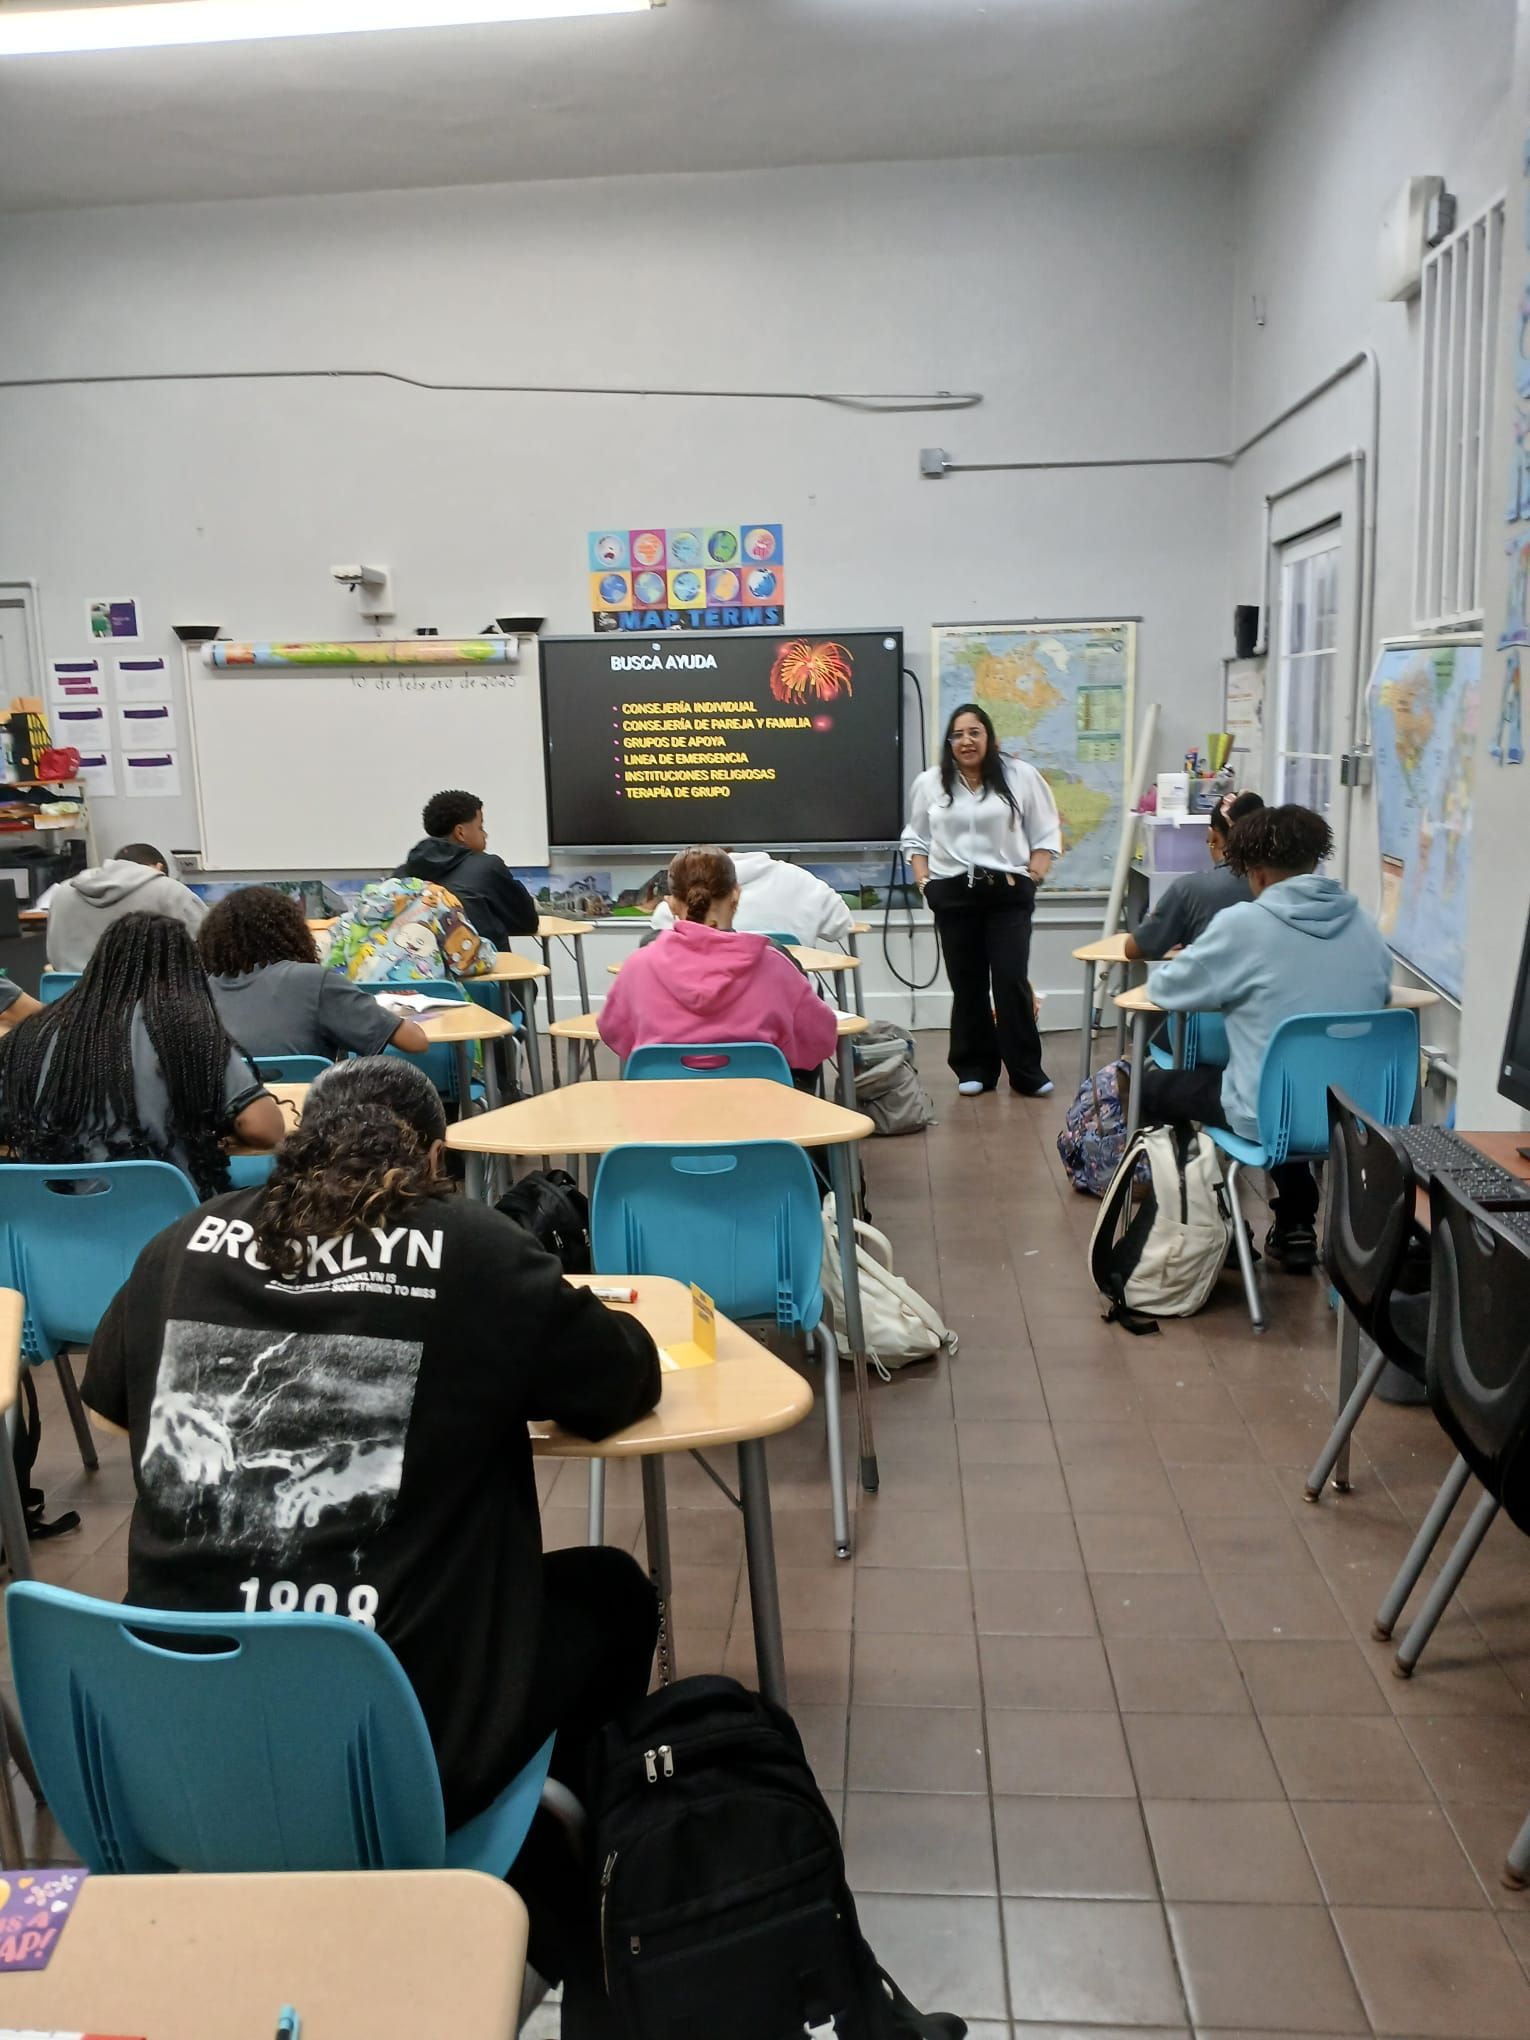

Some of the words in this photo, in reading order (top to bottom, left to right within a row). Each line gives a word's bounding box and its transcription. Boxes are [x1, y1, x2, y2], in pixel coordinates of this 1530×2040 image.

[618, 610, 680, 629] MAP
[688, 606, 779, 627] TERMS
[610, 655, 663, 671] BUSCA
[665, 654, 718, 670] AYUDA
[622, 700, 692, 714] CONSEJERÍA
[693, 701, 758, 713] INDIVIDUAL
[622, 717, 693, 731] CONSEJERÍA
[694, 719, 710, 730] DE
[710, 718, 755, 729] PAREJA
[755, 718, 765, 729] Y
[765, 717, 812, 729] FAMILIA
[623, 737, 670, 748] GRUPOS
[671, 736, 688, 747] DE
[688, 736, 726, 747] APOYA
[624, 754, 657, 765] LINEA
[658, 753, 675, 764] DE
[675, 752, 749, 765] EMERGENCIA
[624, 769, 709, 781] INSTITUCIONES
[710, 768, 776, 780] RELIGIOSAS
[624, 785, 673, 798] TERAPÍA
[673, 786, 690, 798] DE
[691, 786, 731, 798] GRUPO
[394, 1285, 409, 1296] TO
